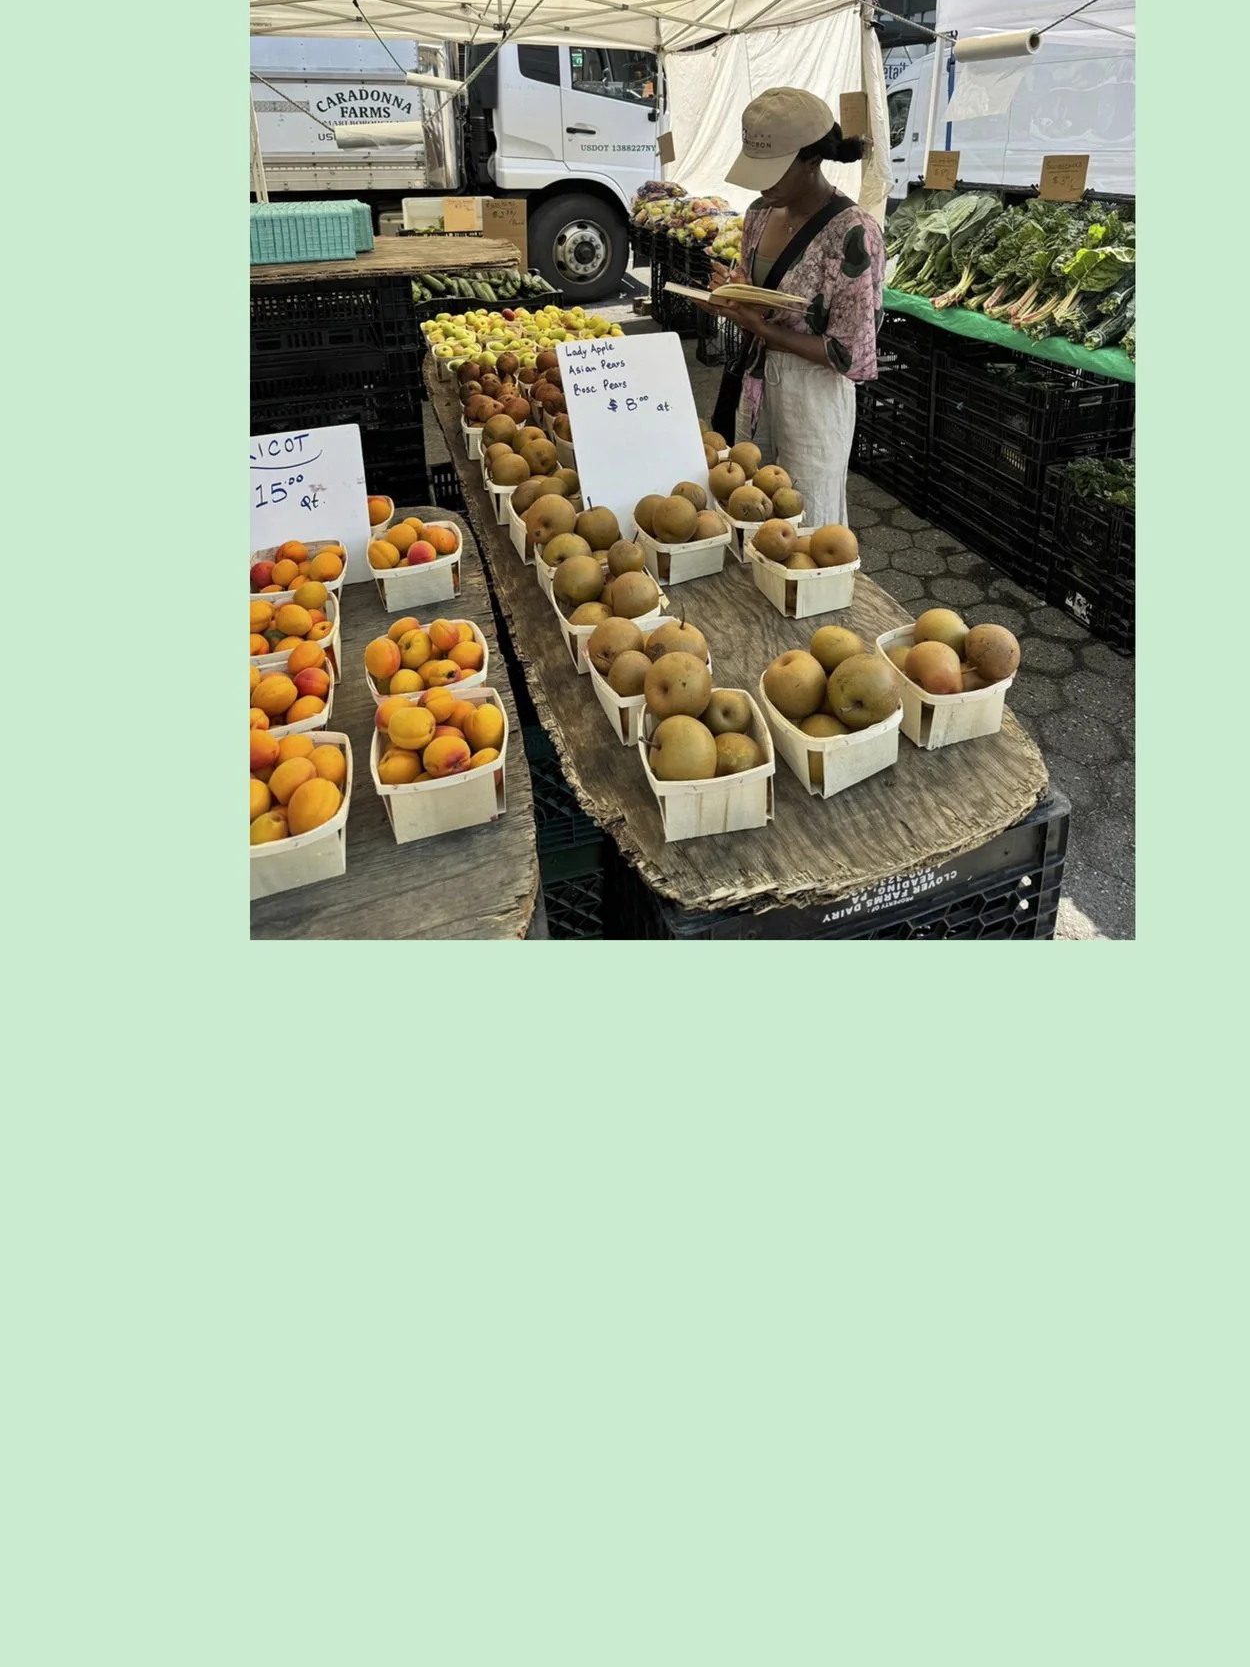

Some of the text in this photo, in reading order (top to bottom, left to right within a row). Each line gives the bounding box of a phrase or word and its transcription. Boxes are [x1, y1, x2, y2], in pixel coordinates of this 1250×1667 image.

[317, 89, 412, 114] CARADONNA
[341, 107, 390, 118] FARMS
[566, 342, 615, 359] Lady Apple
[569, 359, 625, 375] Asian Pears
[603, 379, 627, 390] Pears
[607, 398, 618, 412] $
[250, 434, 309, 460] ICOT
[873, 872, 935, 895] READING,
[912, 870, 957, 894] CLOVER
[852, 892, 868, 904] PA
[866, 889, 908, 907] FARMS
[822, 903, 861, 923] DAIRY
